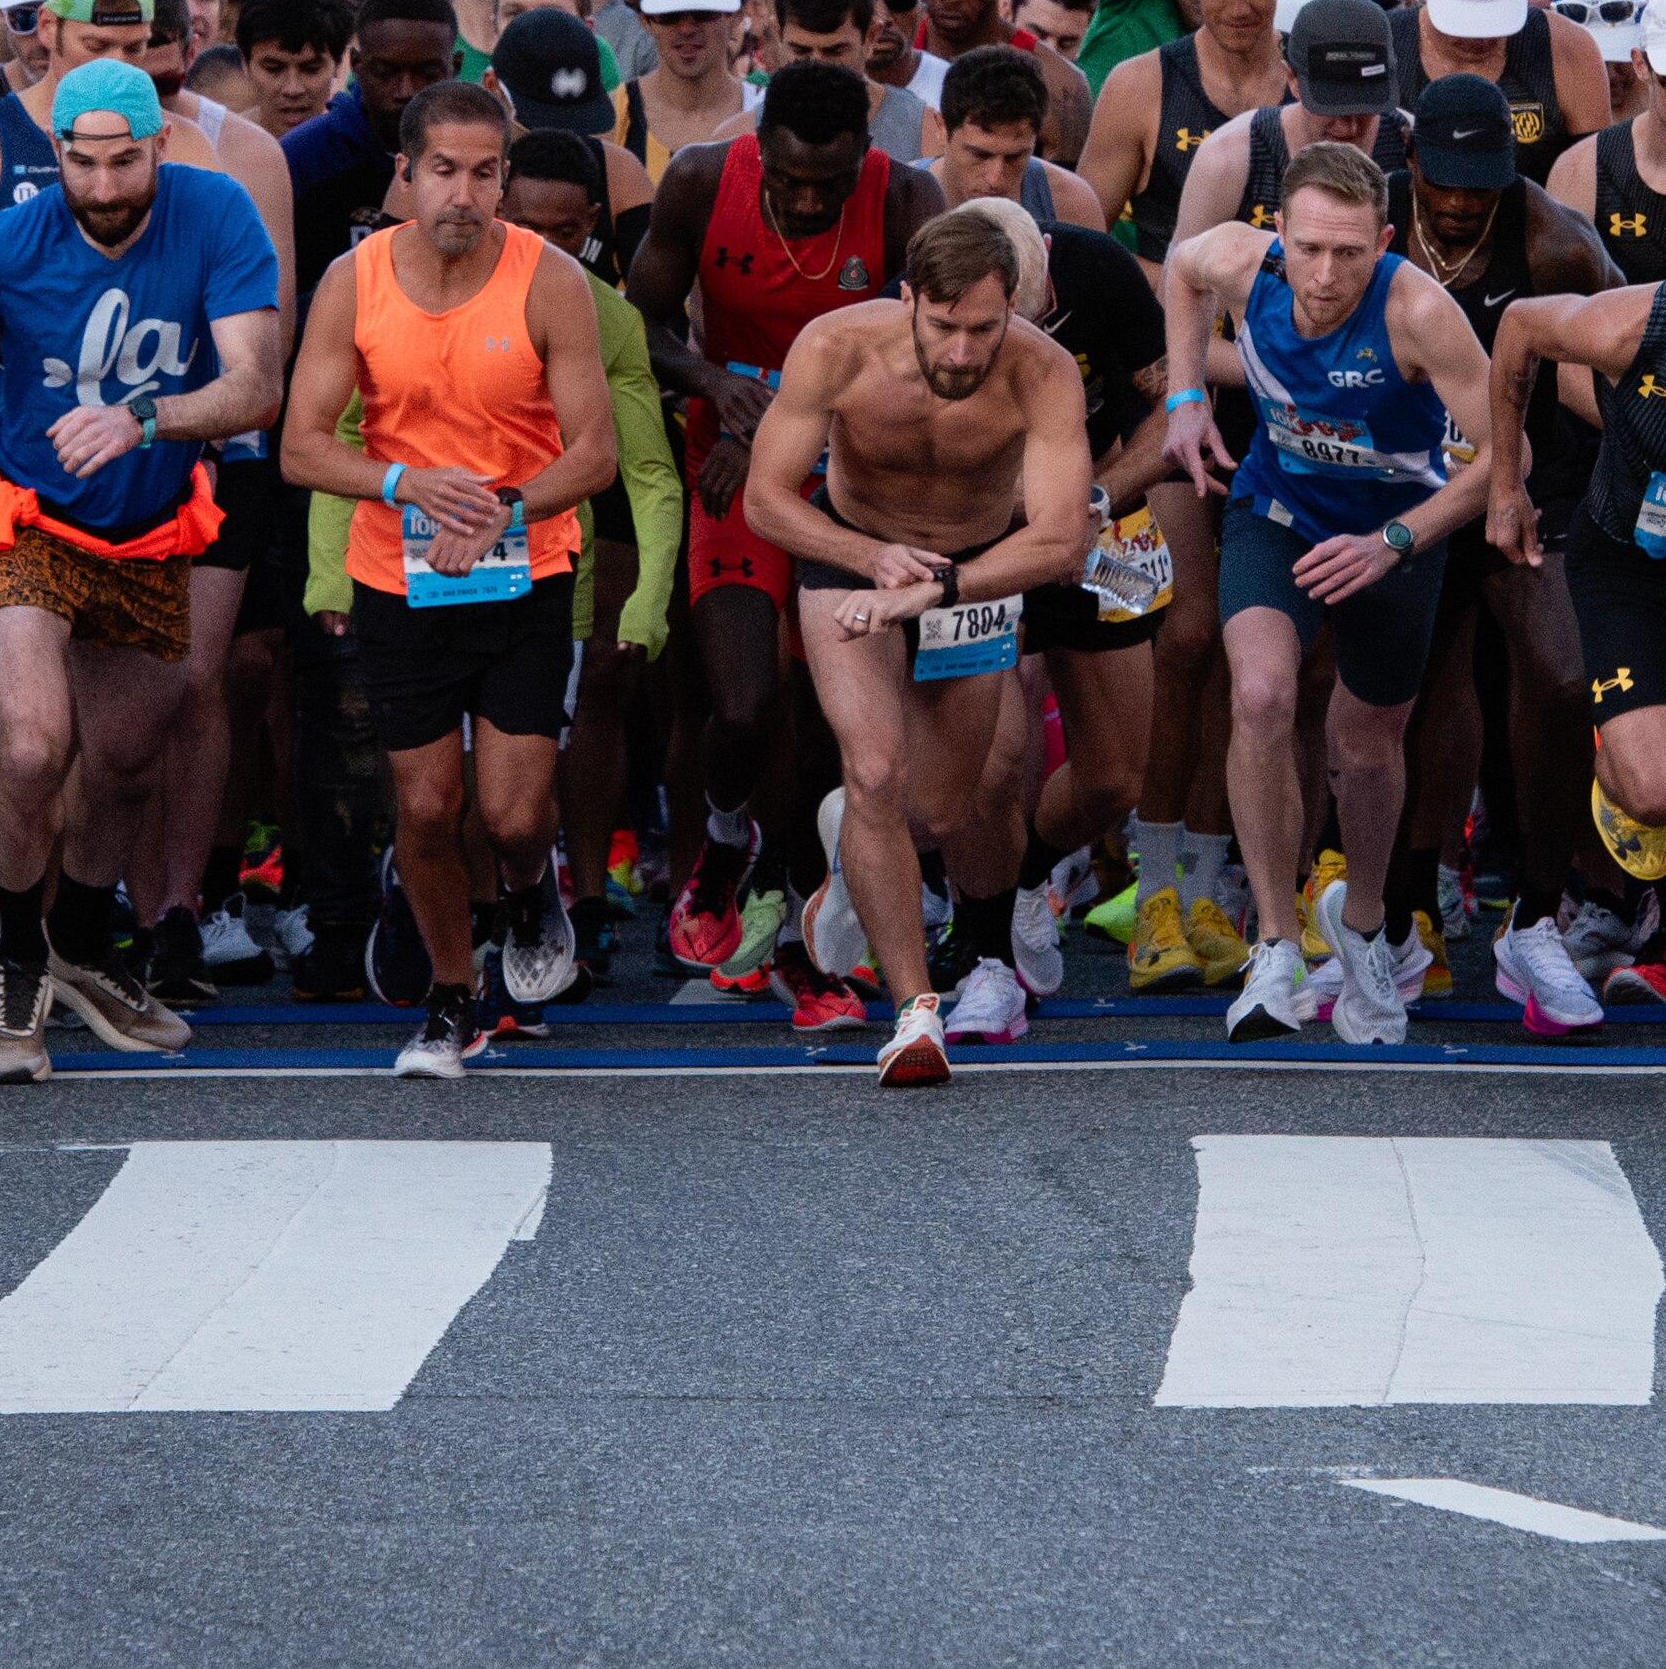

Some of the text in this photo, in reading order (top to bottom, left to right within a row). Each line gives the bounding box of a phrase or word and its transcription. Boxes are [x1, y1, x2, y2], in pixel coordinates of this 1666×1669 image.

[1327, 368, 1385, 389] GRC
[1302, 440, 1360, 465] 8977
[952, 604, 1006, 641] 7804
